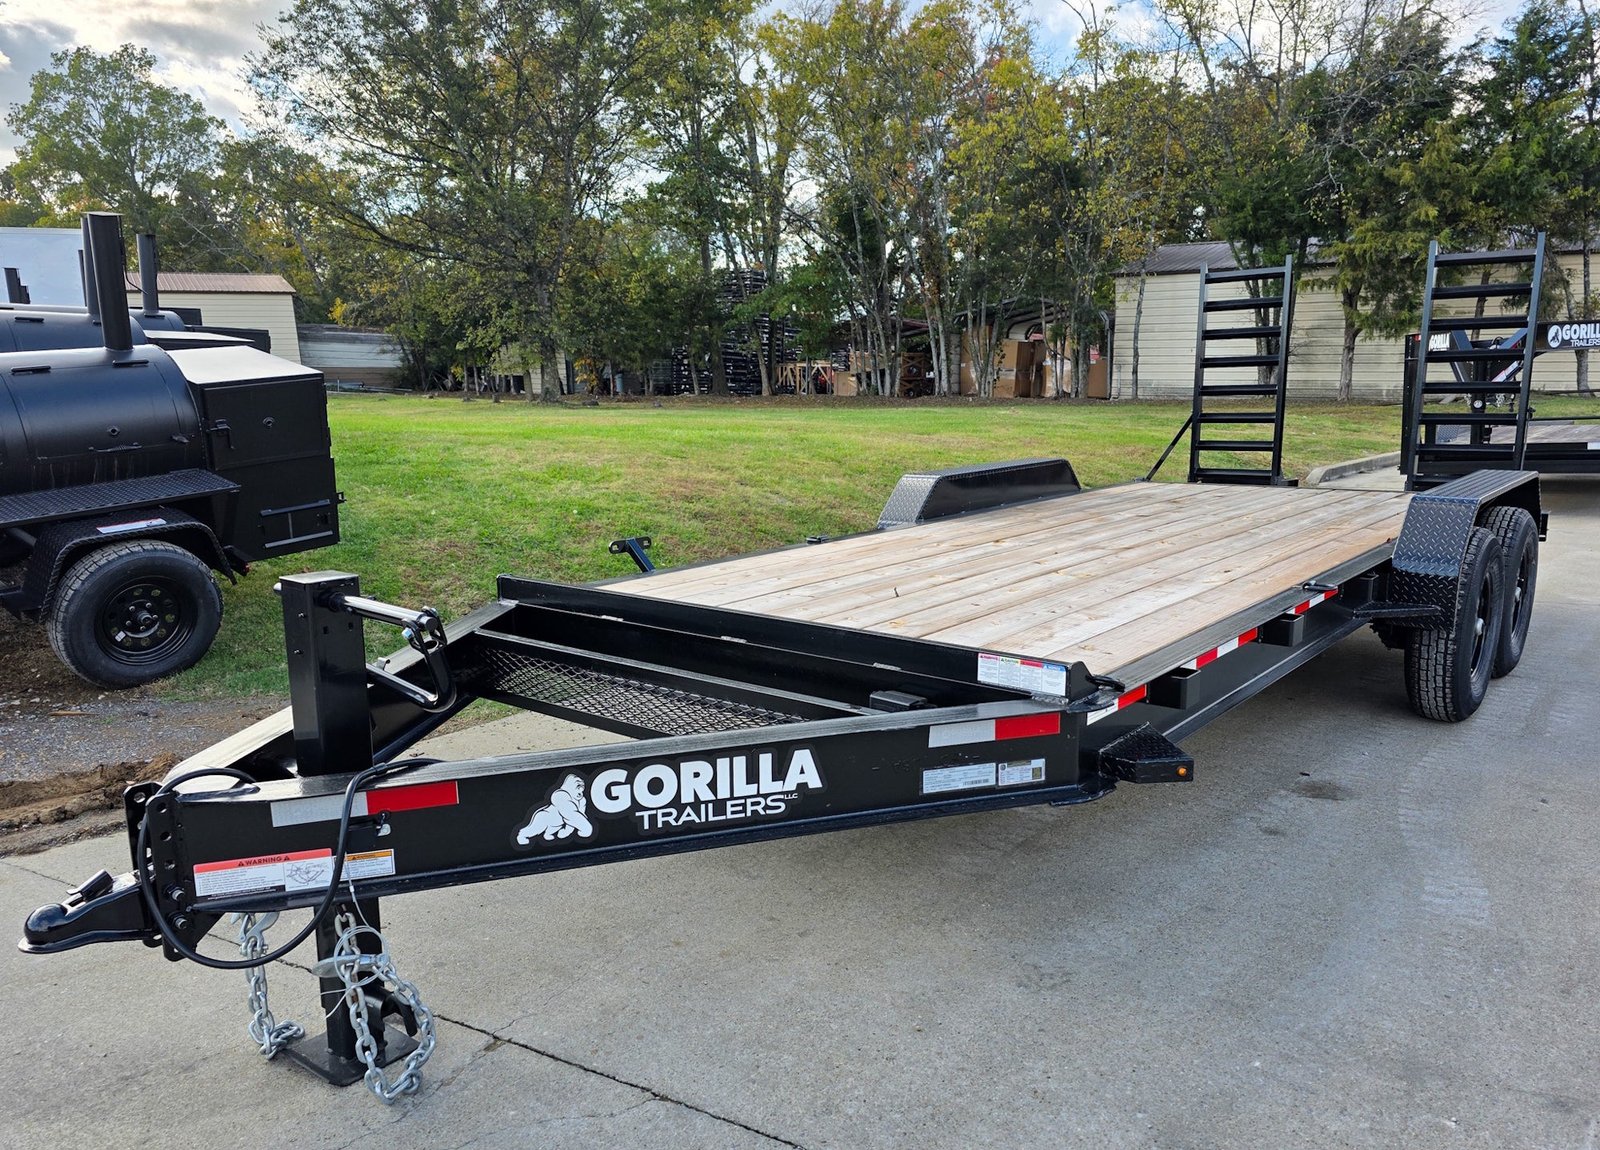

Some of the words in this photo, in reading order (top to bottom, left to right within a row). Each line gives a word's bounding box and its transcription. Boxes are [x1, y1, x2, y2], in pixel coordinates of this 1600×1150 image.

[1562, 323, 1600, 340] GORILL
[590, 749, 823, 814] GORILLA
[635, 794, 786, 830] TRAILERS
[245, 856, 282, 866] WARNING
